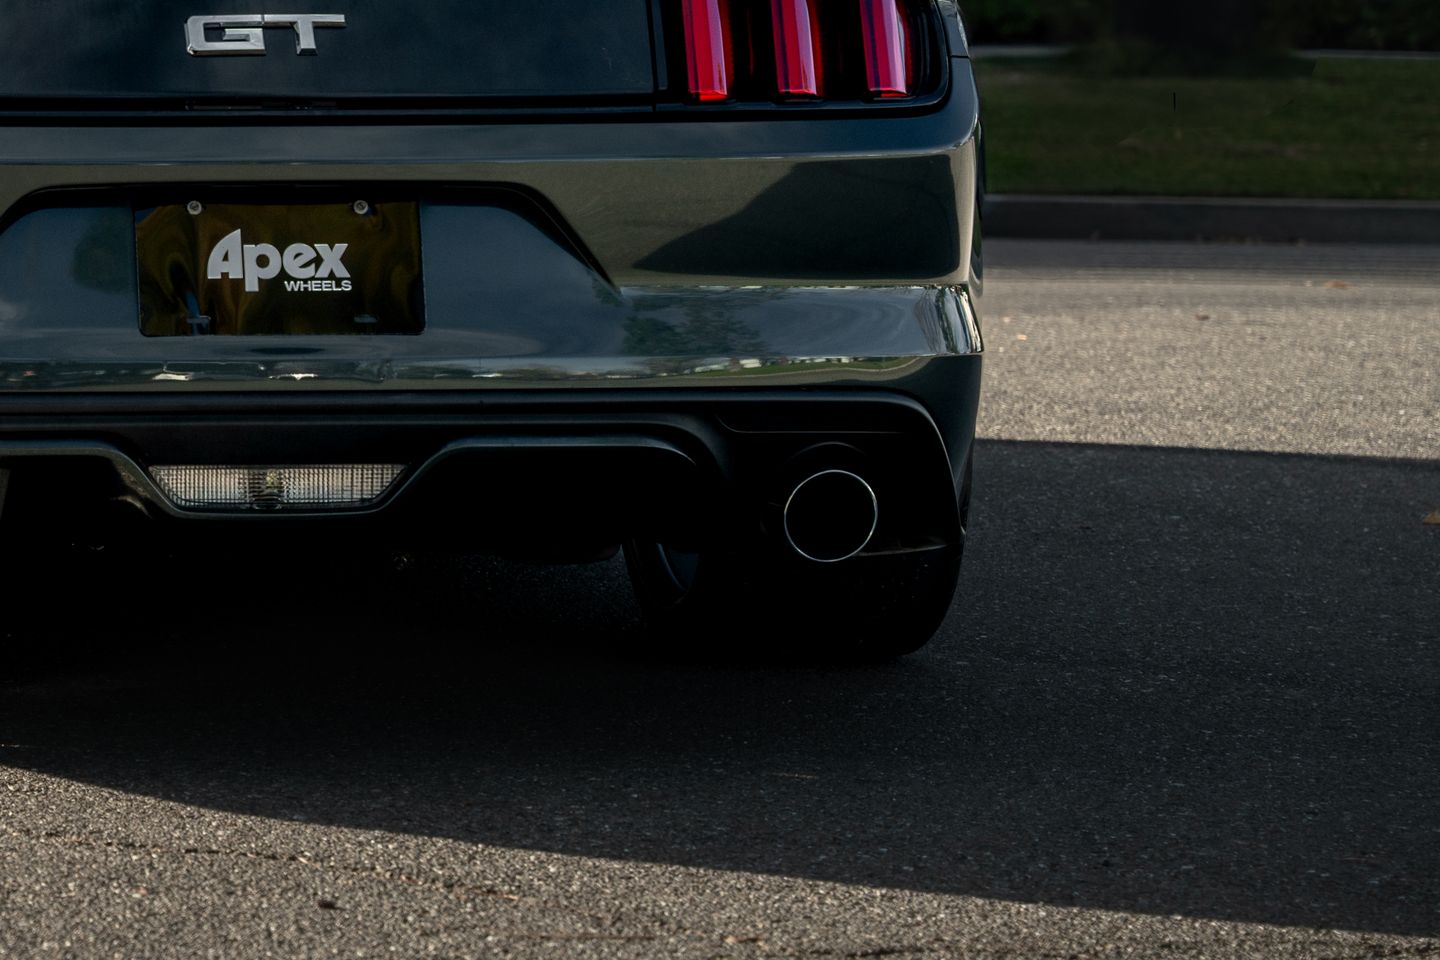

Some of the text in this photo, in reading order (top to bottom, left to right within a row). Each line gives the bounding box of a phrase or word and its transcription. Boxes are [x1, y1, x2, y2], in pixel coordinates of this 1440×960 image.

[184, 14, 347, 57] GT
[207, 228, 351, 292] Apex
[284, 279, 353, 292] WHEELS
